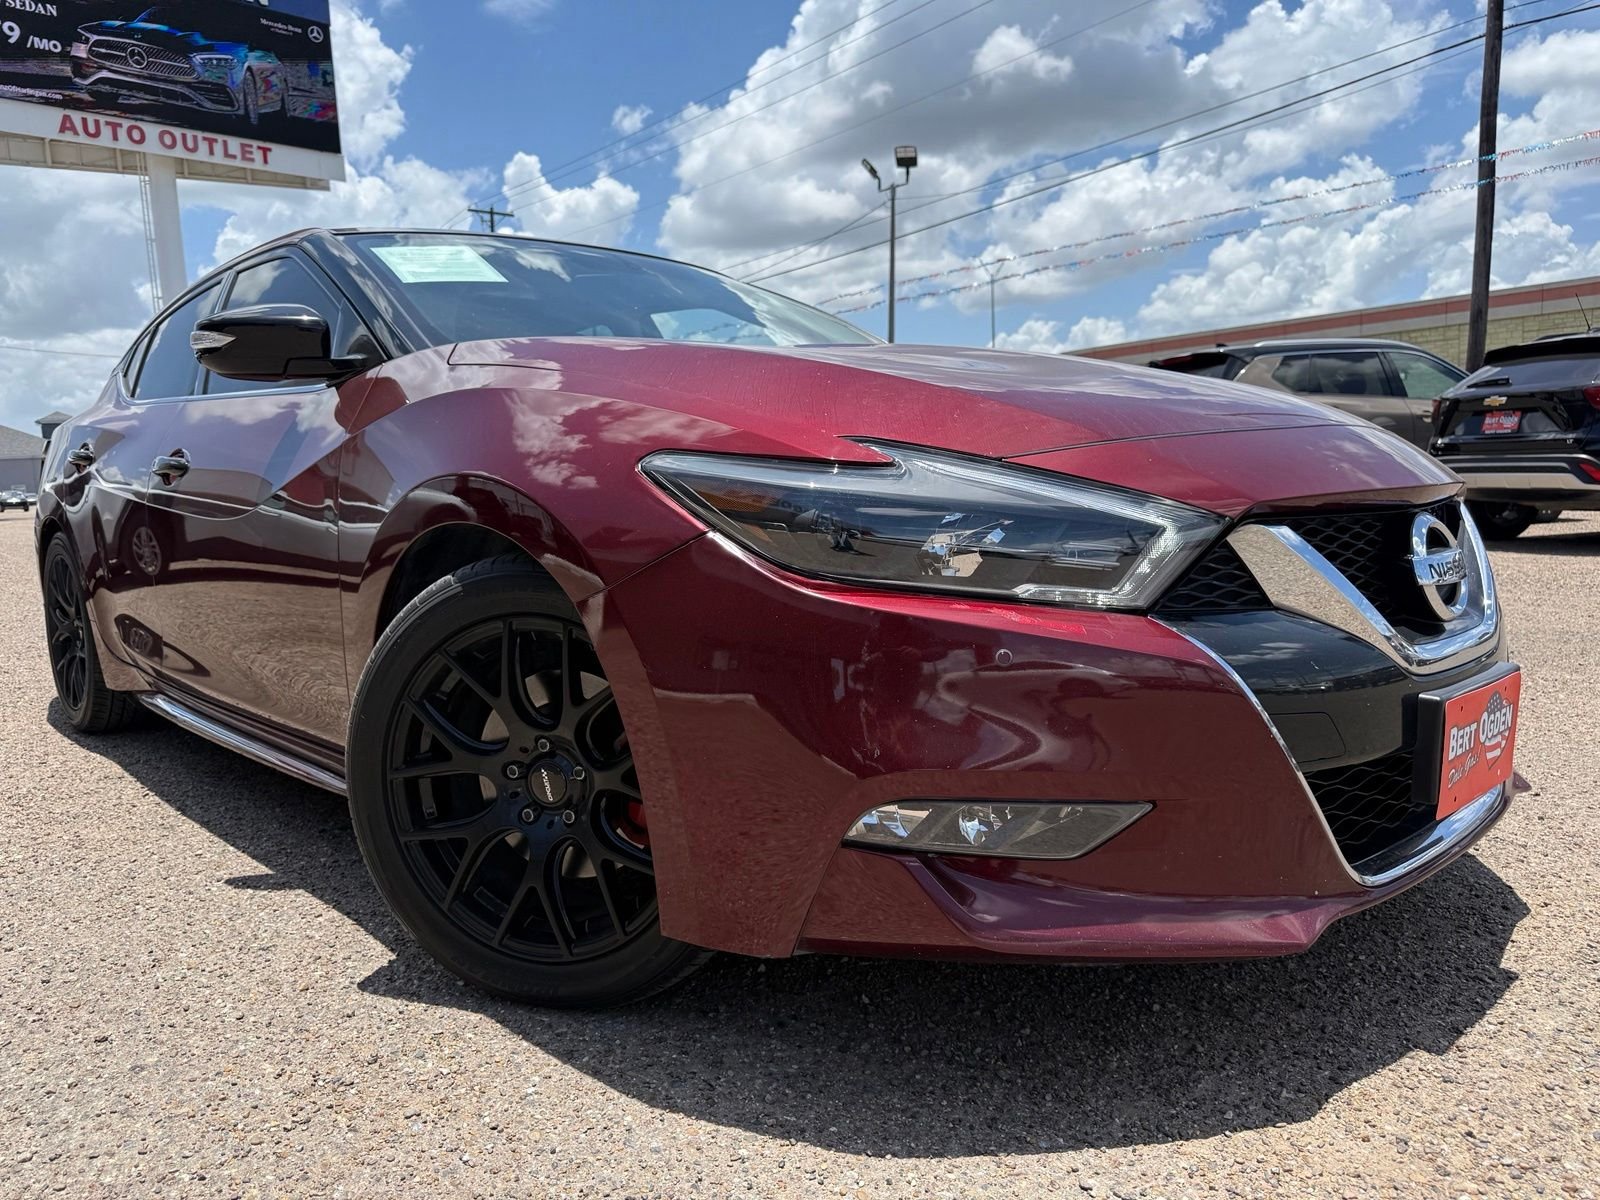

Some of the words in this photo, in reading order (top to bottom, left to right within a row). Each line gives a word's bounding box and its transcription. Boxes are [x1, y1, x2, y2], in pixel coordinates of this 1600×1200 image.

[5, 0, 58, 17] SEDAN
[0, 20, 21, 44] 9
[26, 35, 62, 53] /MO
[58, 113, 146, 145] AUTO
[158, 129, 273, 165] OUTLET
[1449, 723, 1477, 760] BERT
[1480, 704, 1513, 743] OGDEN
